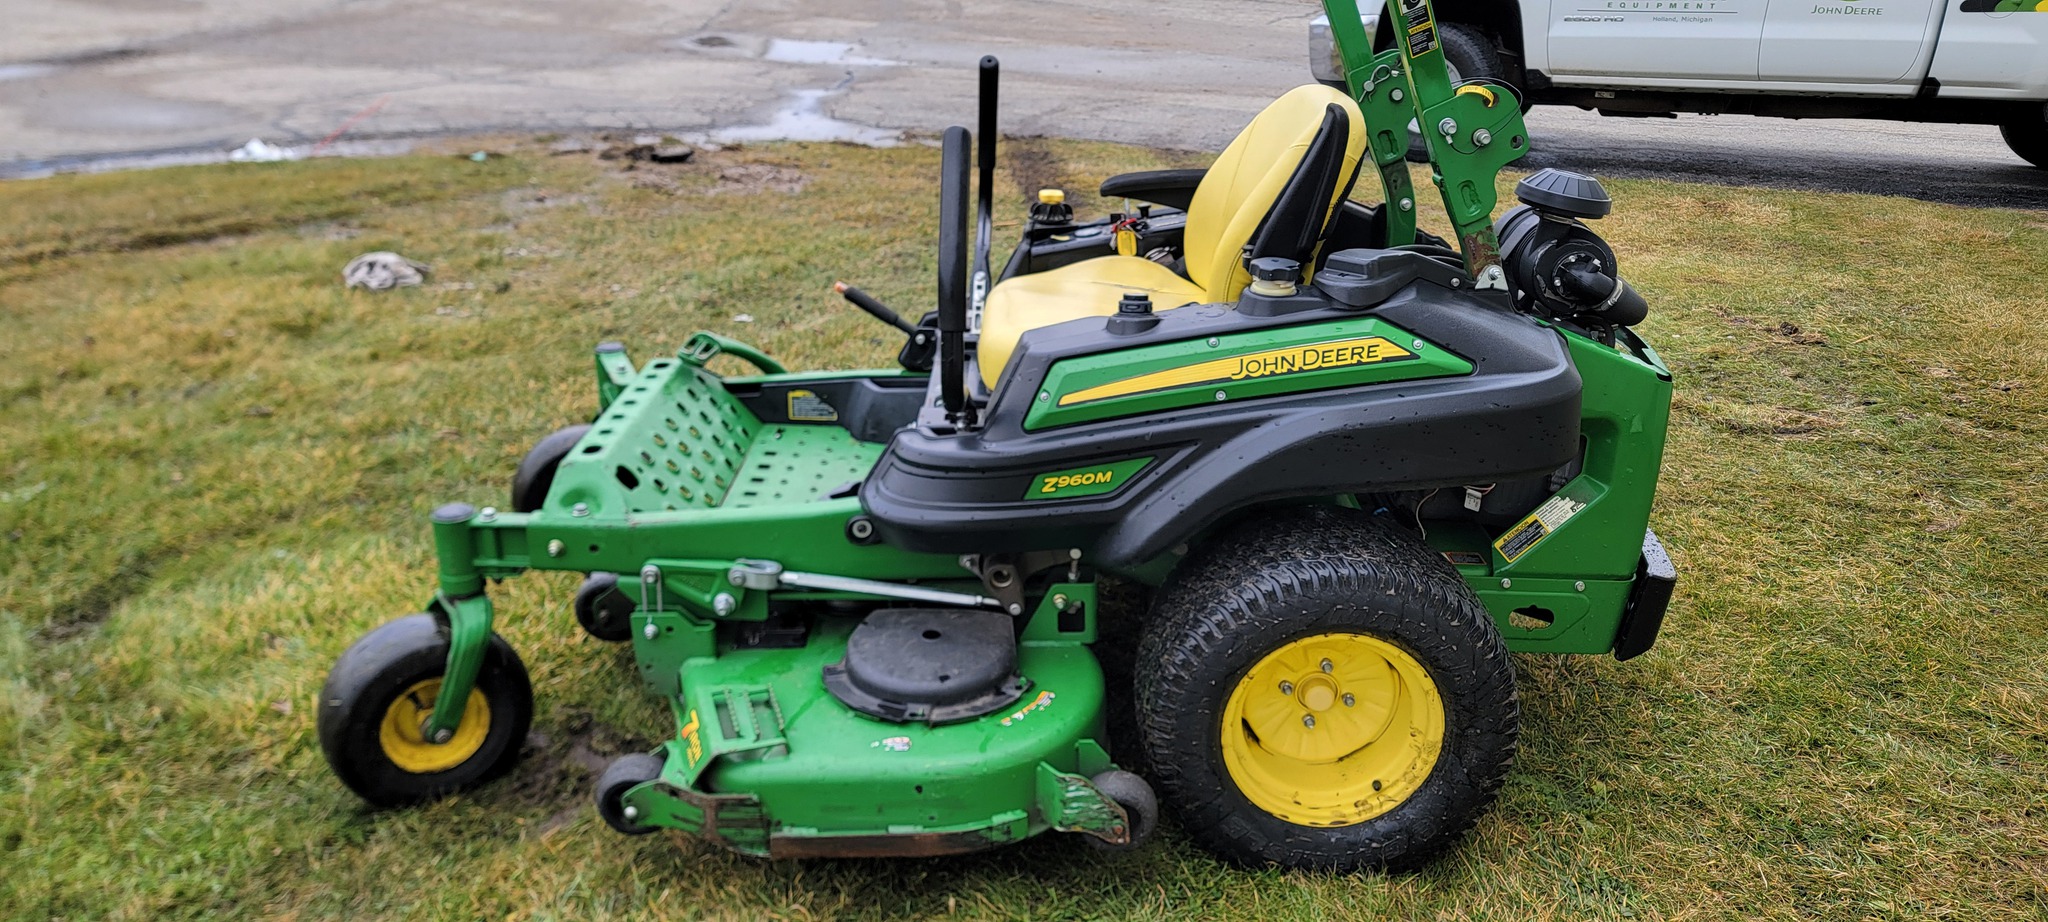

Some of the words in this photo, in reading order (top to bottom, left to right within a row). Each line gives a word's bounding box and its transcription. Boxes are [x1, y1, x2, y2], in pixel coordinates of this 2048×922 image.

[1811, 5, 1842, 15] JOHN
[1844, 5, 1883, 16] DEERE
[1231, 354, 1296, 376] JOHN
[1303, 344, 1380, 366] DEERE
[1041, 470, 1113, 493] Z960M
